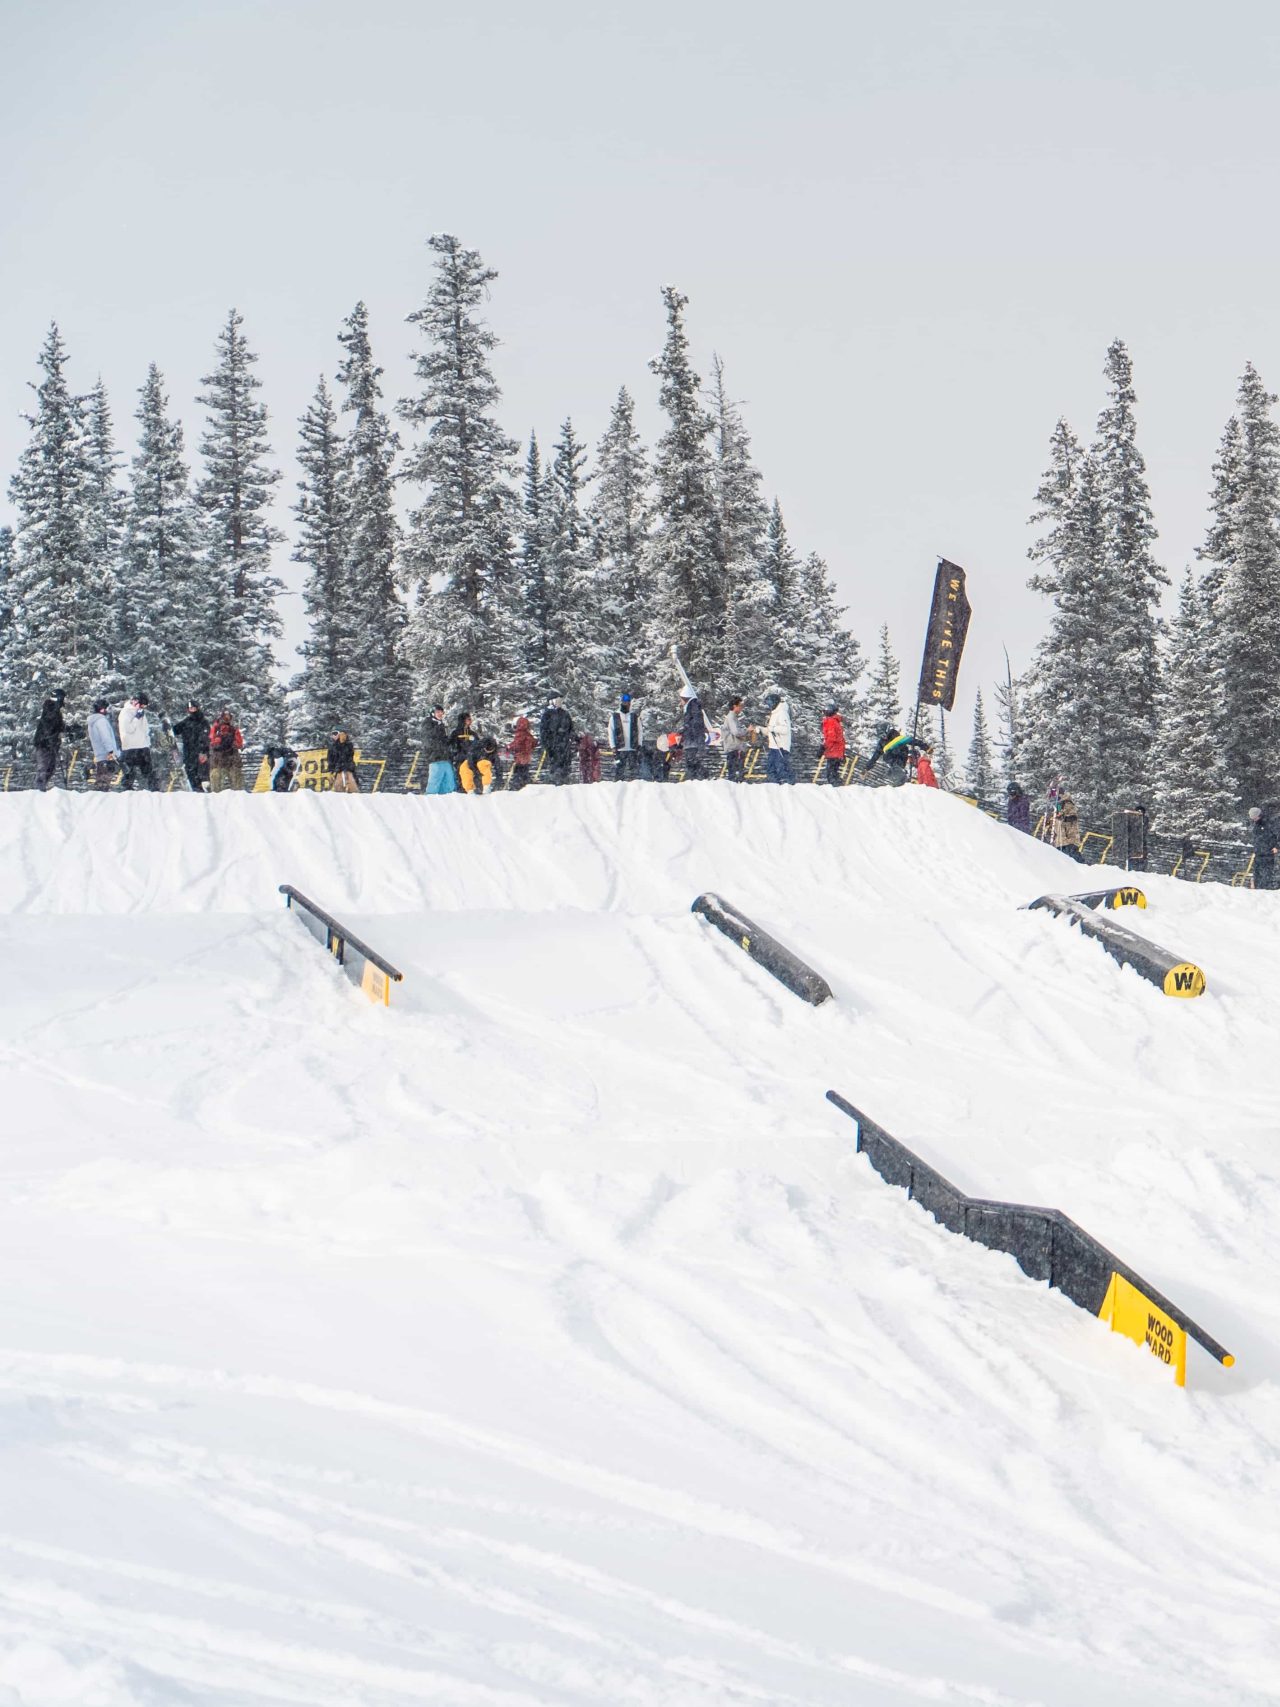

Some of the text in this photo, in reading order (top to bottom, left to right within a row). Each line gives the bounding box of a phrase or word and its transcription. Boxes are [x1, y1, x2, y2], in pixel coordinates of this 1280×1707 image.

[948, 578, 961, 602] WE
[932, 658, 949, 699] THIS
[1148, 1313, 1173, 1348] WOOD
